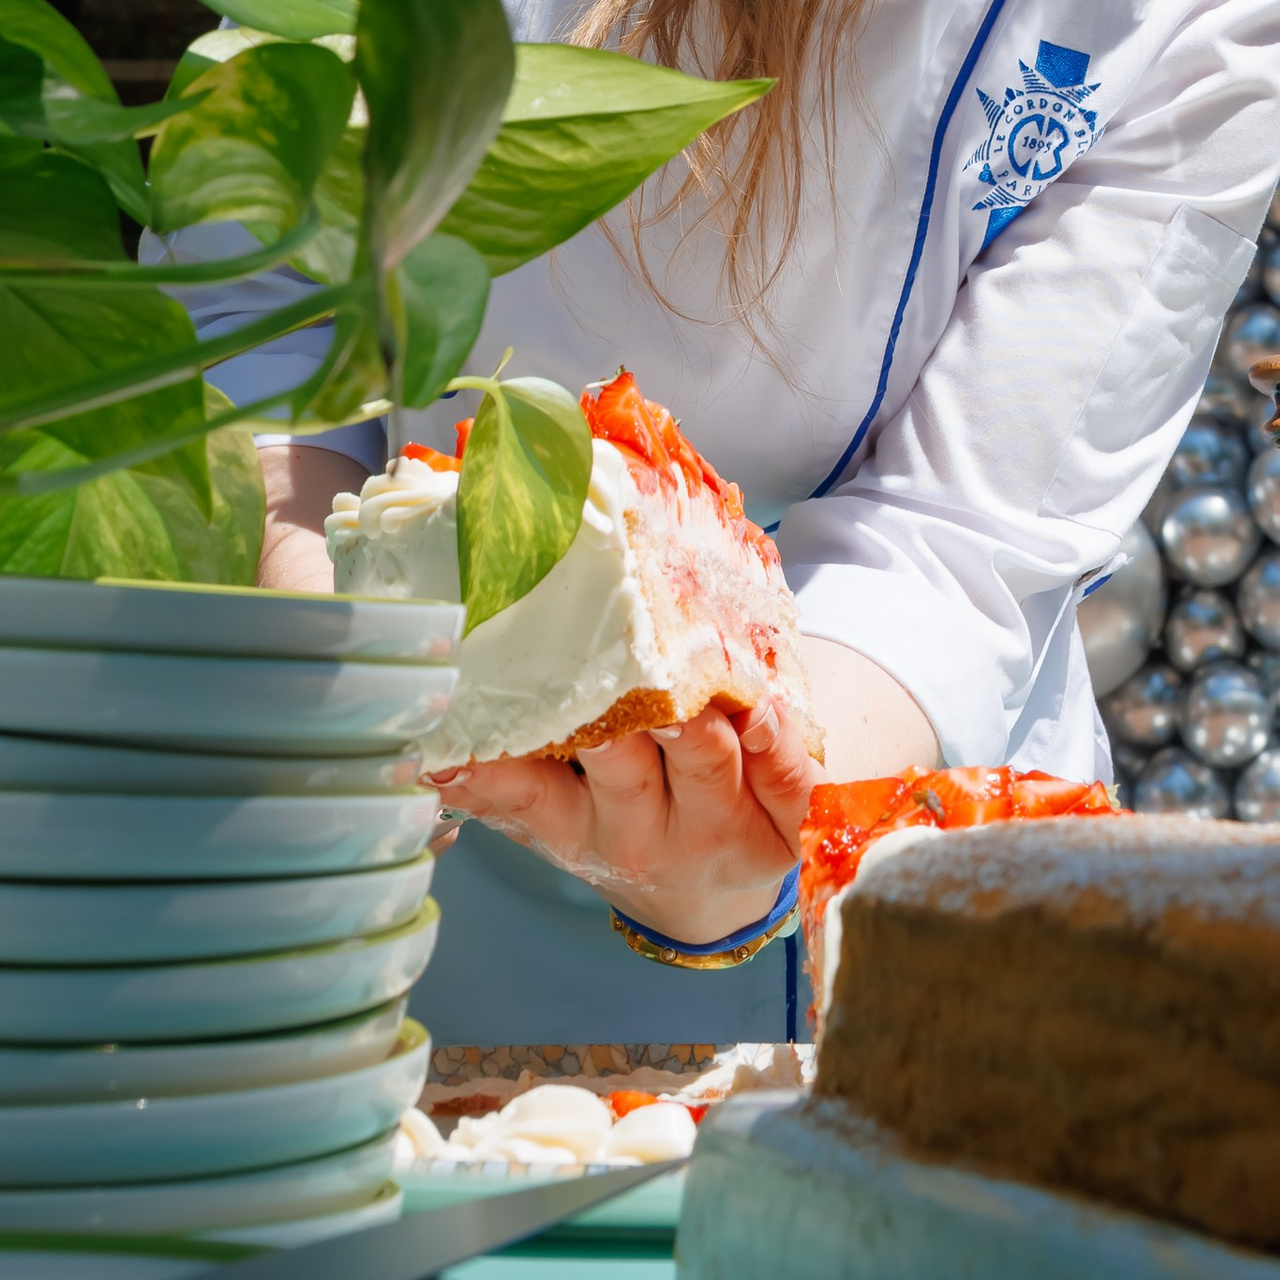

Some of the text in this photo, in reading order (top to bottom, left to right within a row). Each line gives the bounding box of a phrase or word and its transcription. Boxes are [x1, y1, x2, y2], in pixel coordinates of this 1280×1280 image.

[994, 134, 1006, 153] LE
[1005, 98, 1076, 124] CORDON
[1022, 136, 1052, 153] 1895
[997, 170, 1051, 196] PARI
